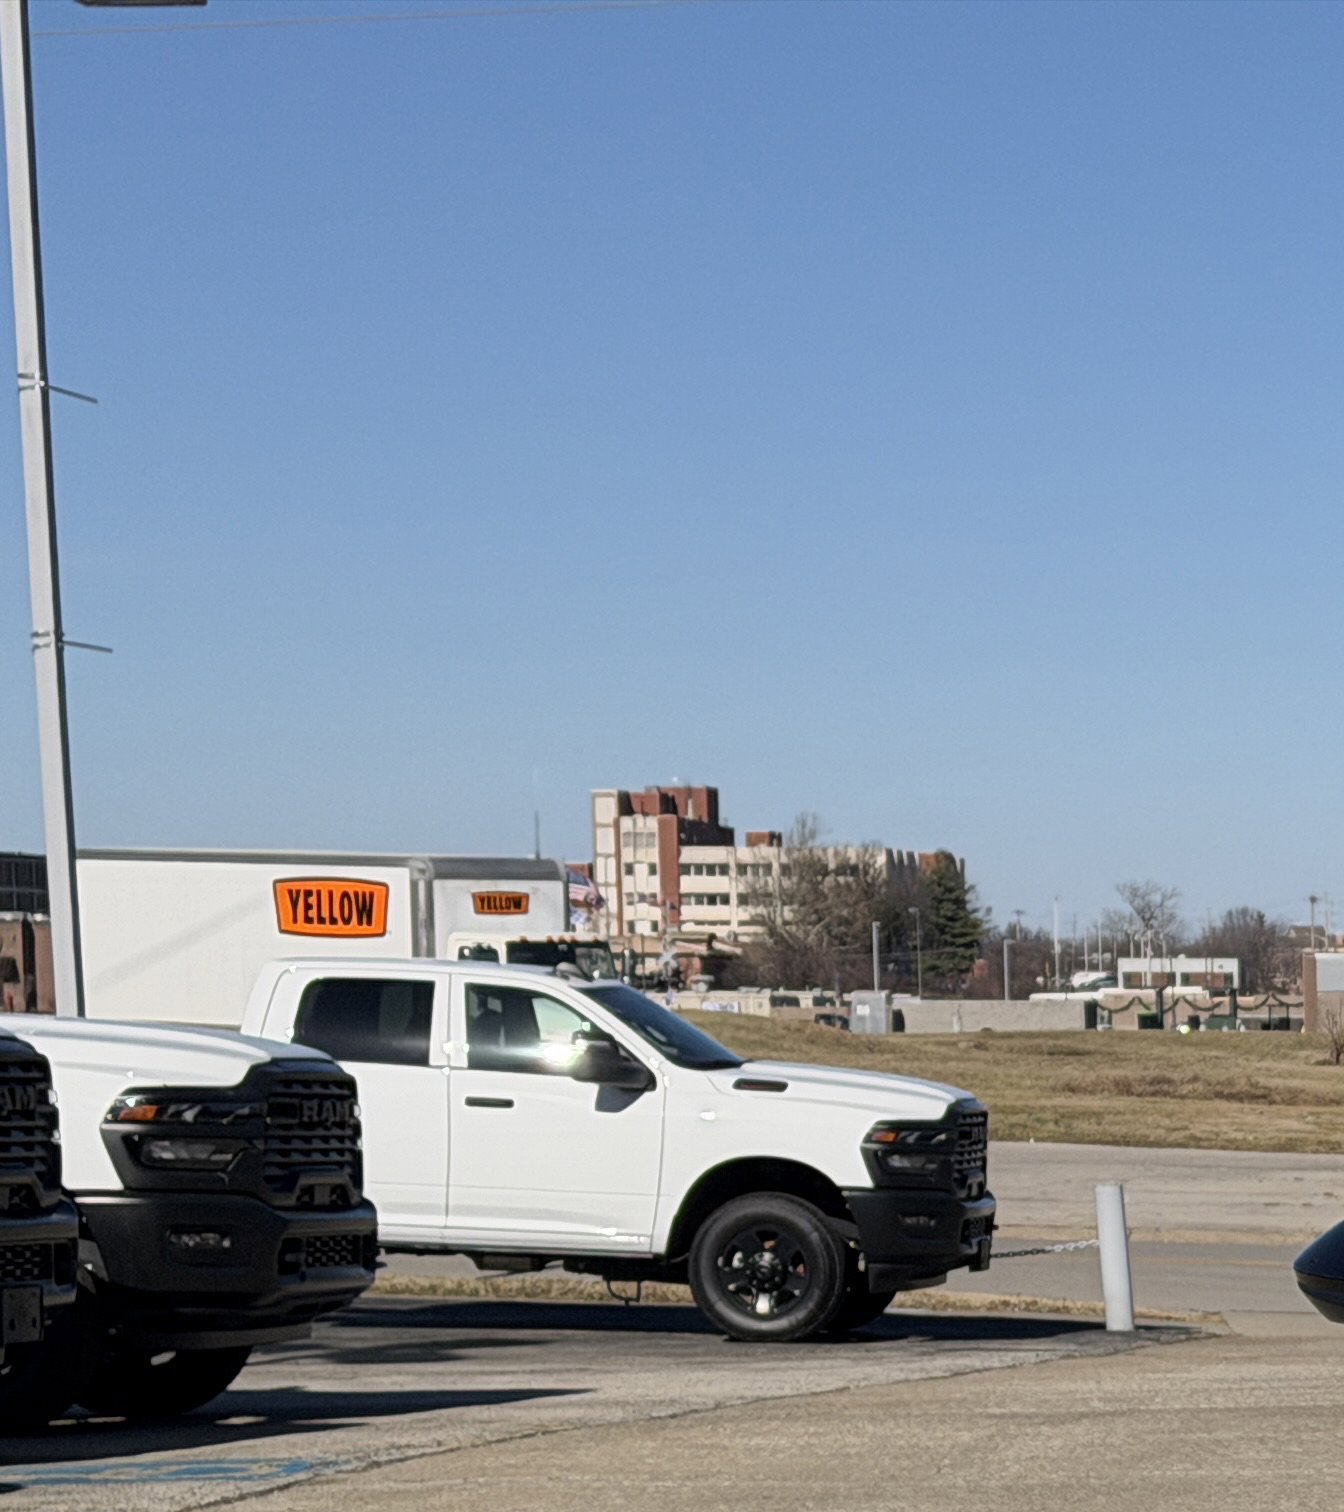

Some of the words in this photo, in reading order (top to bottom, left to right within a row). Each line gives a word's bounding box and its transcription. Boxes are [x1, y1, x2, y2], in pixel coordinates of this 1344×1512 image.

[287, 889, 375, 926] YELLOW
[478, 895, 522, 910] YELLOW
[0, 1085, 34, 1116] AM
[302, 1098, 350, 1124] RAM
